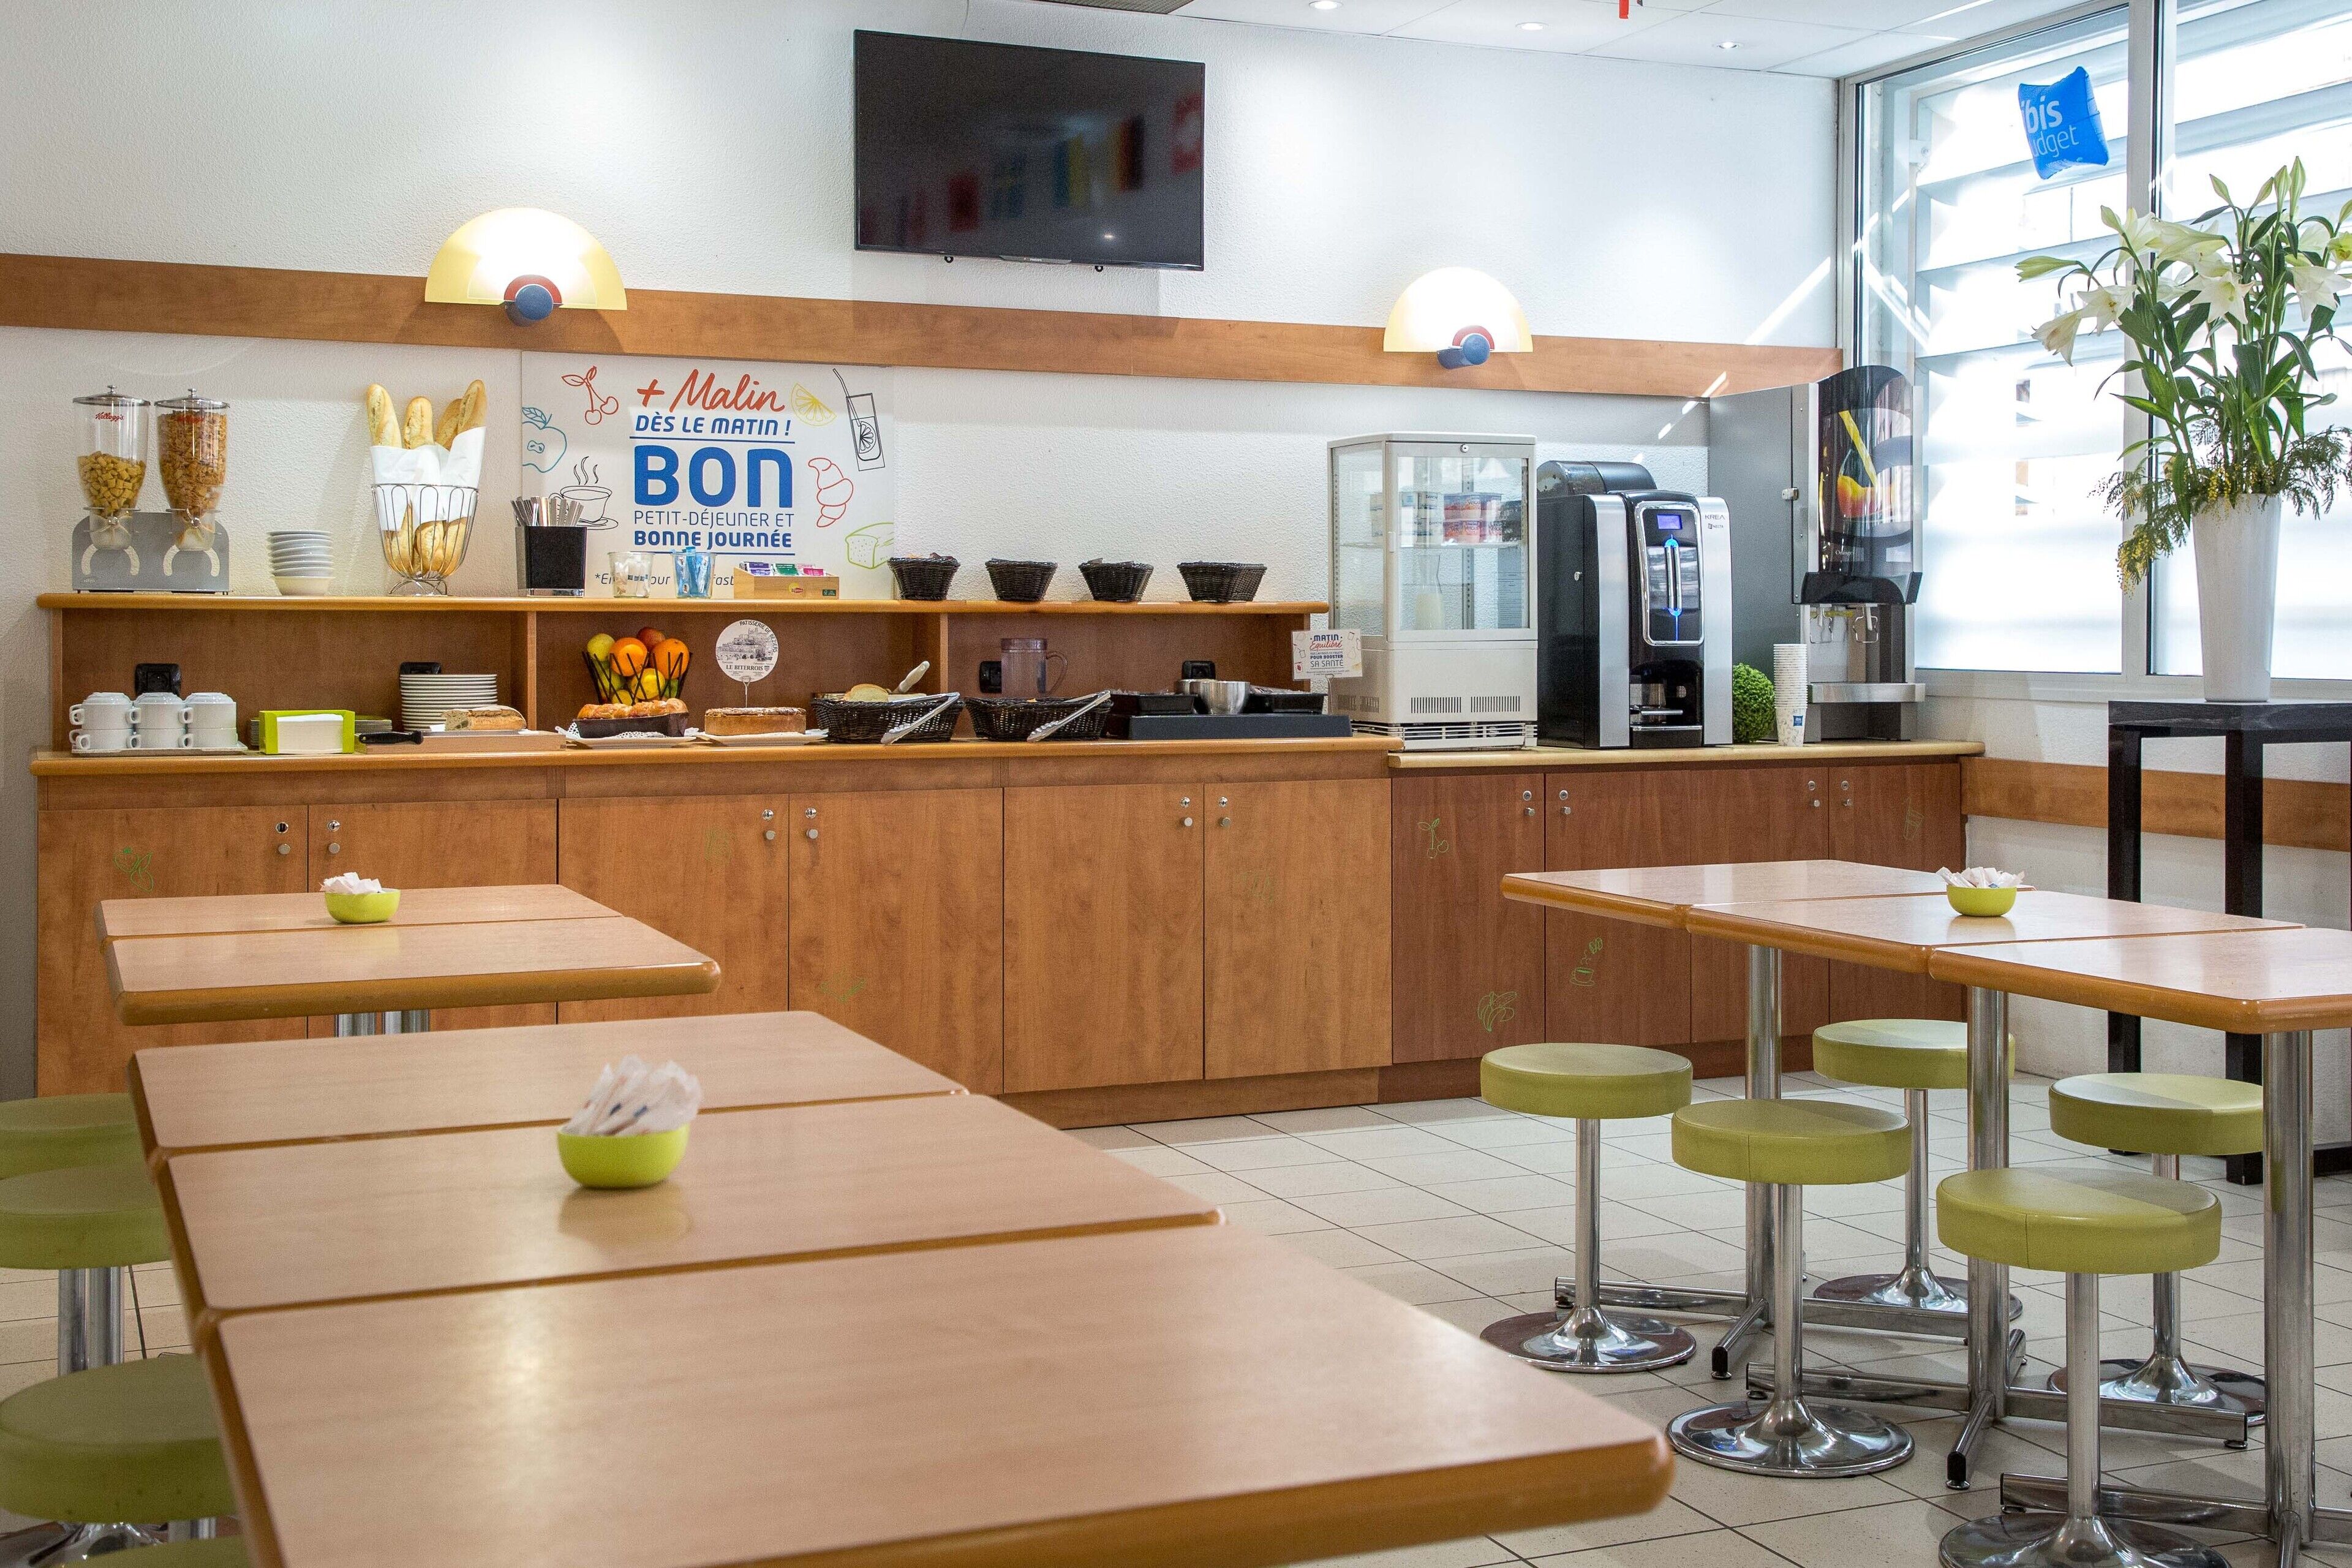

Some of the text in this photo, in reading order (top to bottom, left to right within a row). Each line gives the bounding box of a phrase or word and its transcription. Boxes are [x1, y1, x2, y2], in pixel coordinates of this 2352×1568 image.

[2030, 124, 2079, 157] udget
[669, 368, 785, 413] Malin
[95, 412, 124, 422] Kellogg's
[635, 412, 674, 432] DÈS
[682, 417, 704, 433] LE
[710, 418, 778, 435] MATIN
[634, 445, 793, 508] BON
[634, 508, 794, 529] PETIT-DÉJEUNER ET
[634, 529, 791, 550] BONNE JOURNÉE
[650, 574, 670, 585] our
[1322, 658, 1344, 667] SANTÉ
